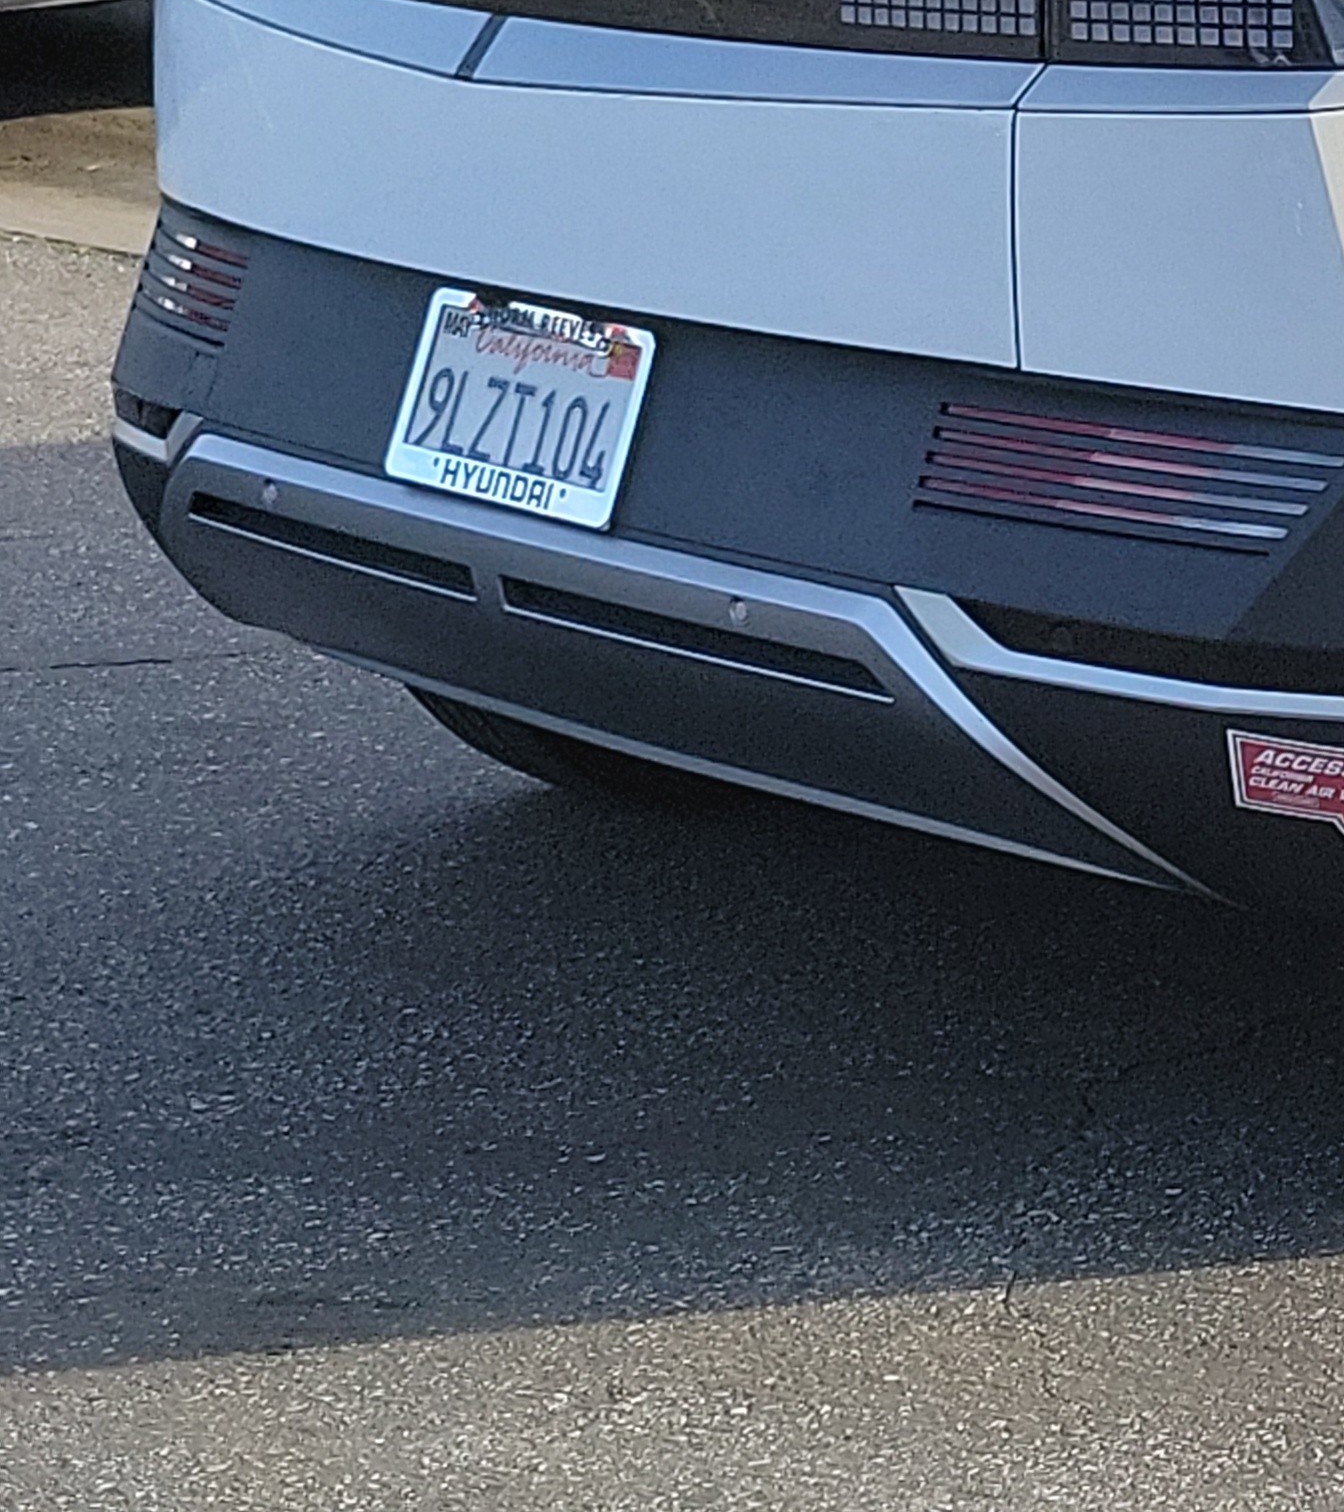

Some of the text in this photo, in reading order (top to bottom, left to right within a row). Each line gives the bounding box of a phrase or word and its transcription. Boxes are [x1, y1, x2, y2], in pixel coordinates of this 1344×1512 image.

[413, 367, 611, 488] 9LZT104
[440, 458, 554, 511] HYUNDAI
[1248, 775, 1302, 794] CLEAN
[1306, 784, 1337, 800] AIR
